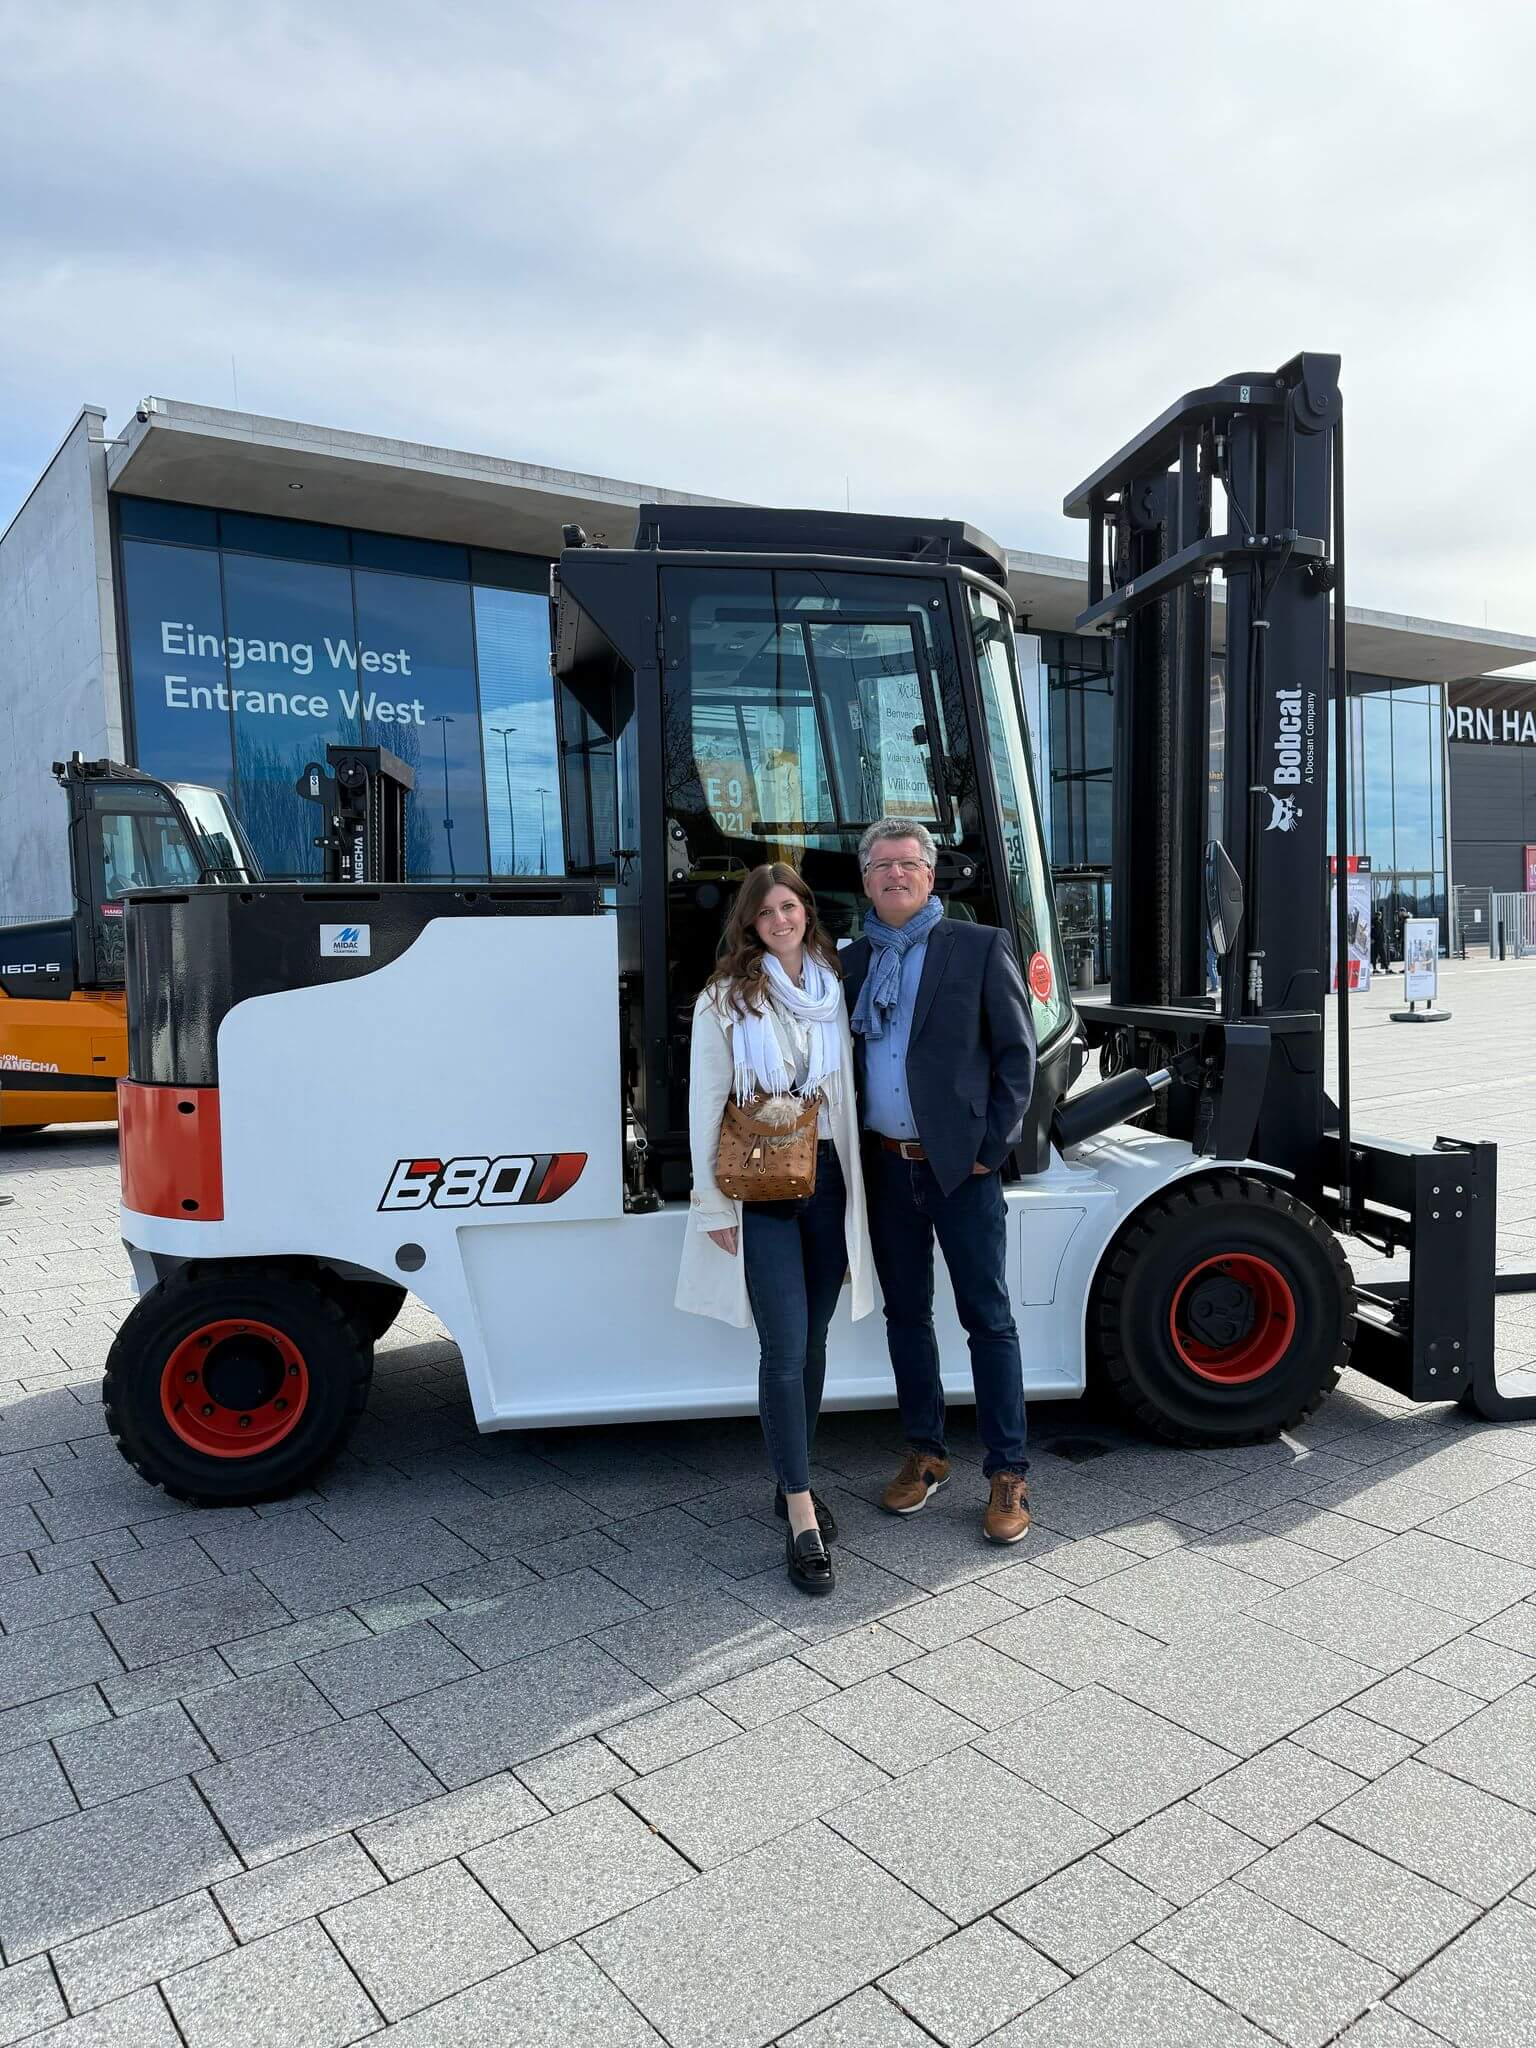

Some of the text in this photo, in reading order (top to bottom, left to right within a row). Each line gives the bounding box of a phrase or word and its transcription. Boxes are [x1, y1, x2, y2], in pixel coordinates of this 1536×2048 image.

[161, 621, 412, 676] Eingang West
[164, 675, 426, 725] Entrance West
[1273, 689, 1302, 785] Bobcat
[1305, 692, 1317, 784] A Doosan Company
[377, 1155, 536, 1211] B80
